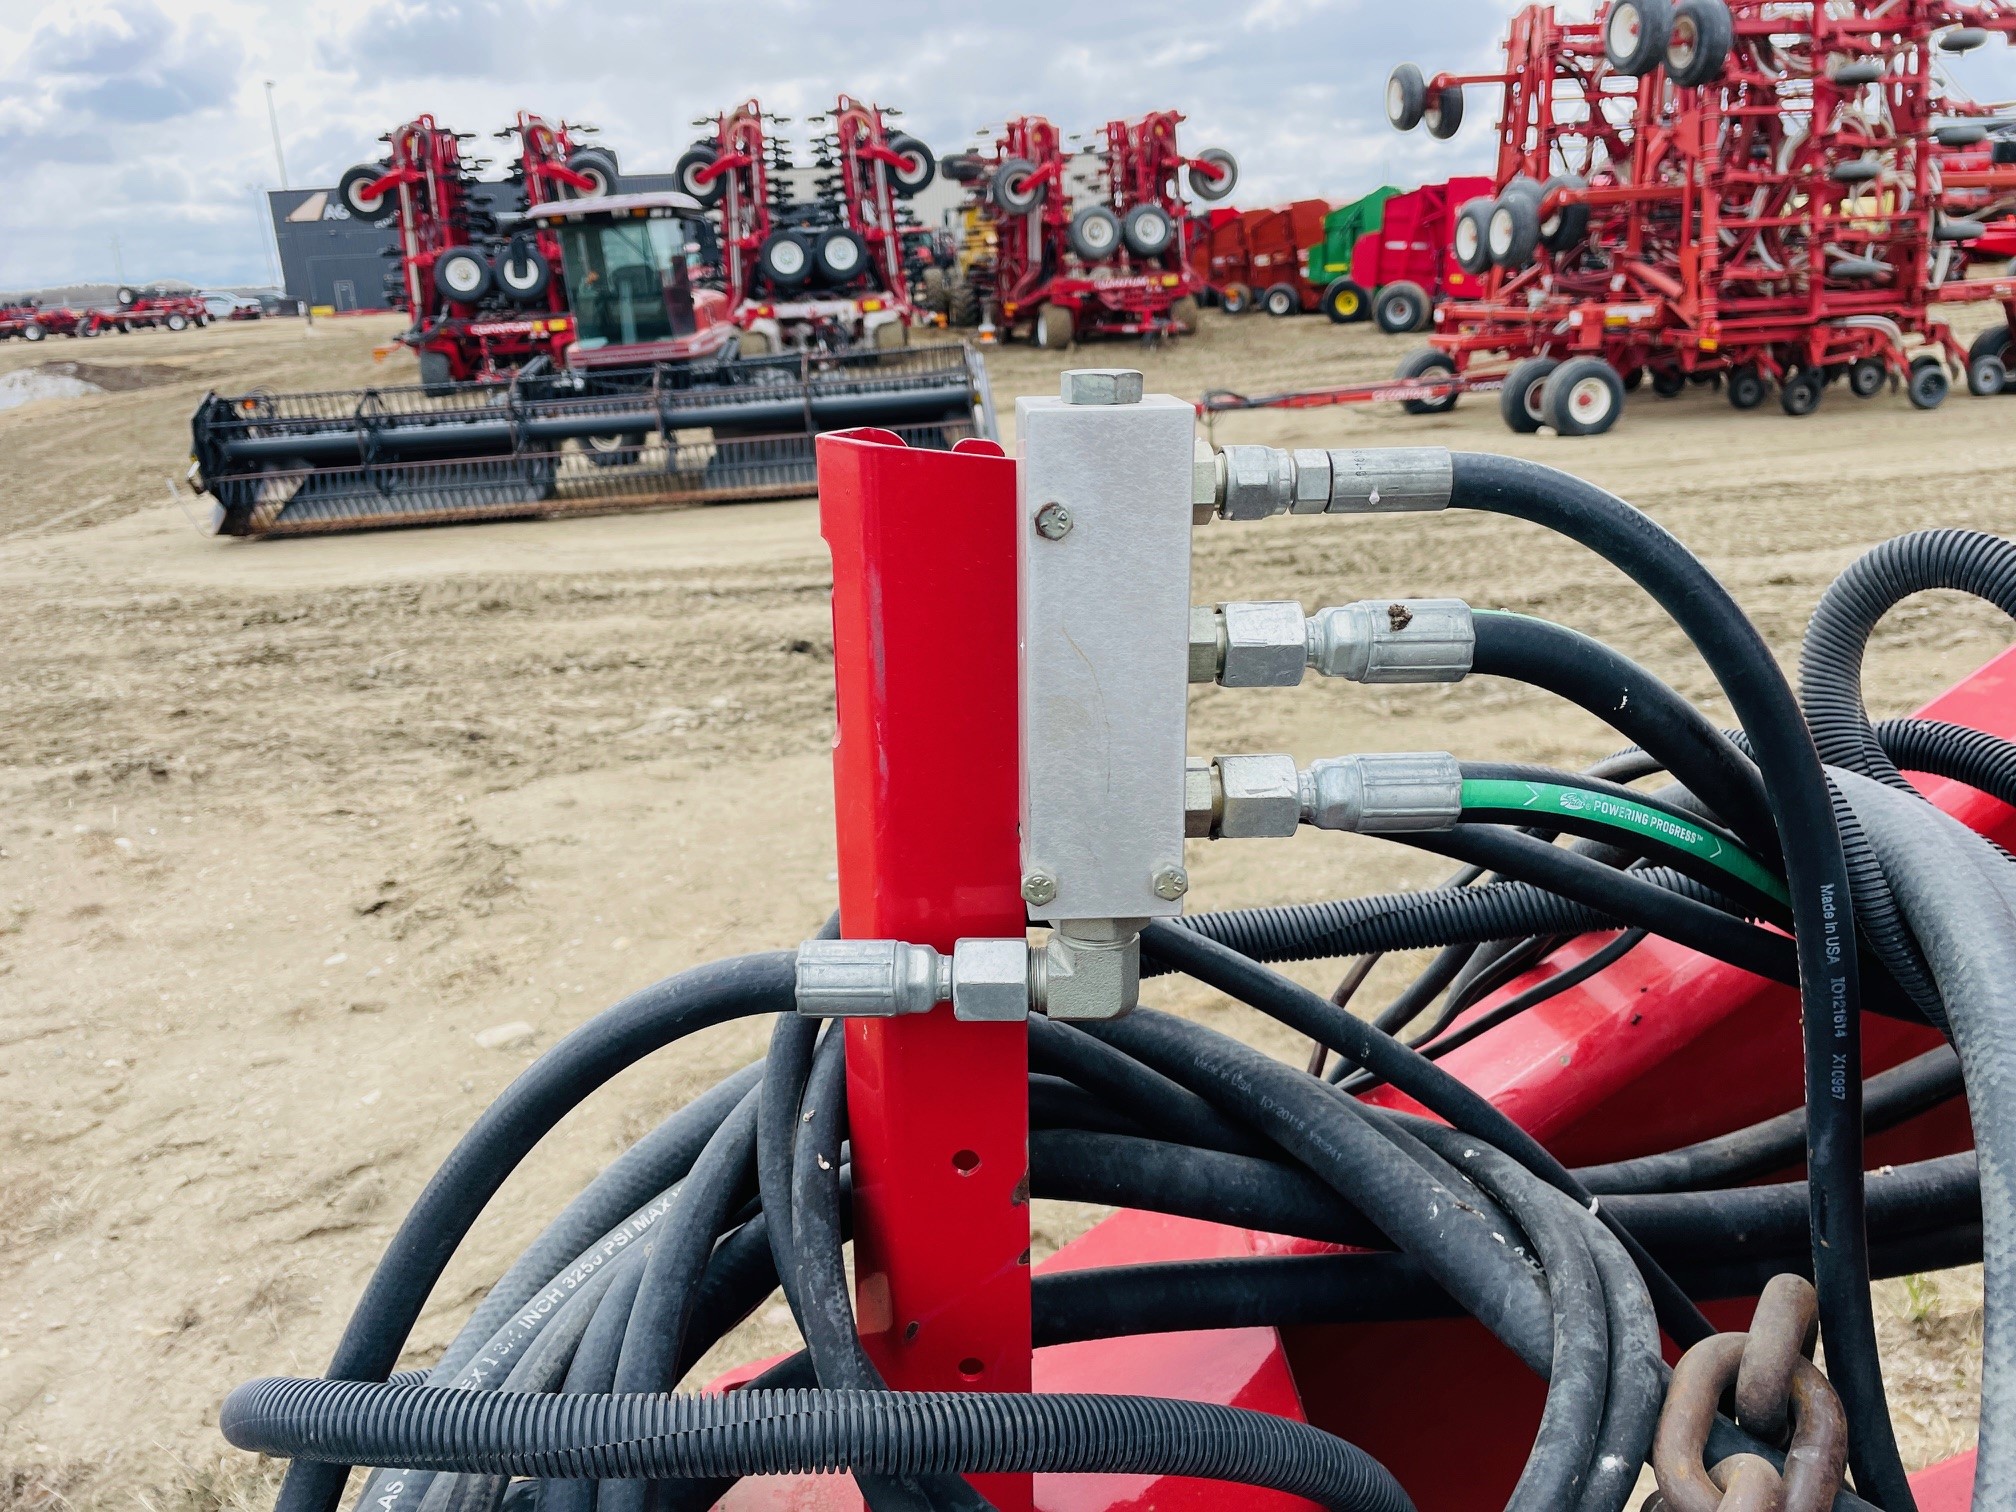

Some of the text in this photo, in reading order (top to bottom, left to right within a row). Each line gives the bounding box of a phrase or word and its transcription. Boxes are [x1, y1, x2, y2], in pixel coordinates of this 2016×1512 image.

[1593, 799, 1649, 826] POWERING
[1820, 882, 1837, 919] Made
[1824, 921, 1836, 936] in
[1825, 936, 1841, 965] USA
[518, 1288, 565, 1330] INCH
[601, 1227, 634, 1256] PSI
[632, 1197, 672, 1232] MAX
